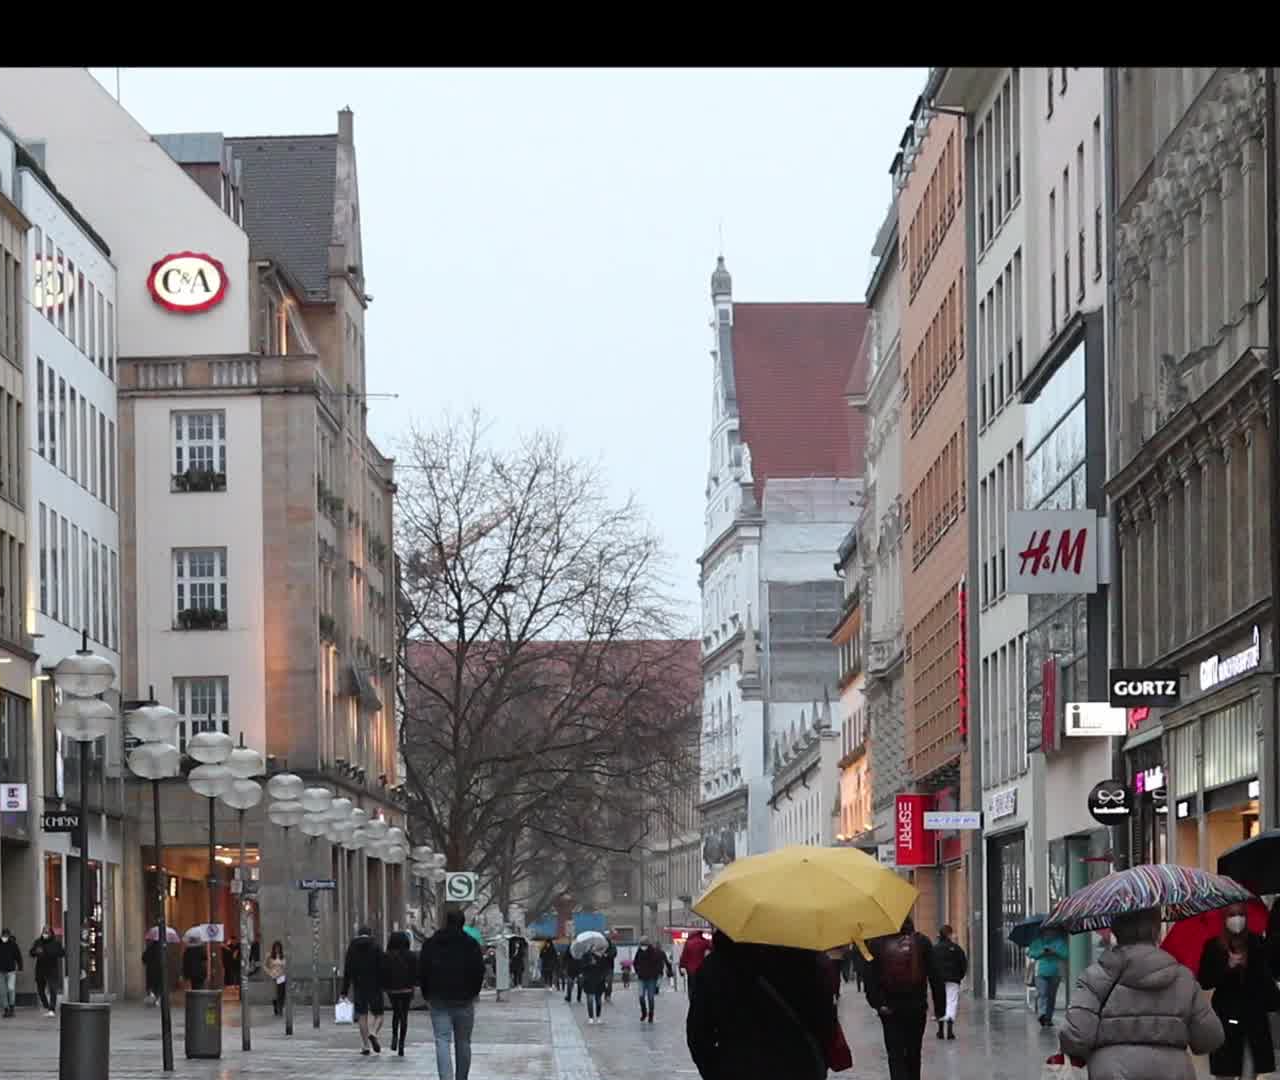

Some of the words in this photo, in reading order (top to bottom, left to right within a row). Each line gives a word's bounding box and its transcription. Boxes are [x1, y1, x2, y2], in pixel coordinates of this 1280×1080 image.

[162, 267, 212, 294] C&A
[1018, 527, 1088, 577] H&M
[898, 801, 913, 850] ESPRIT
